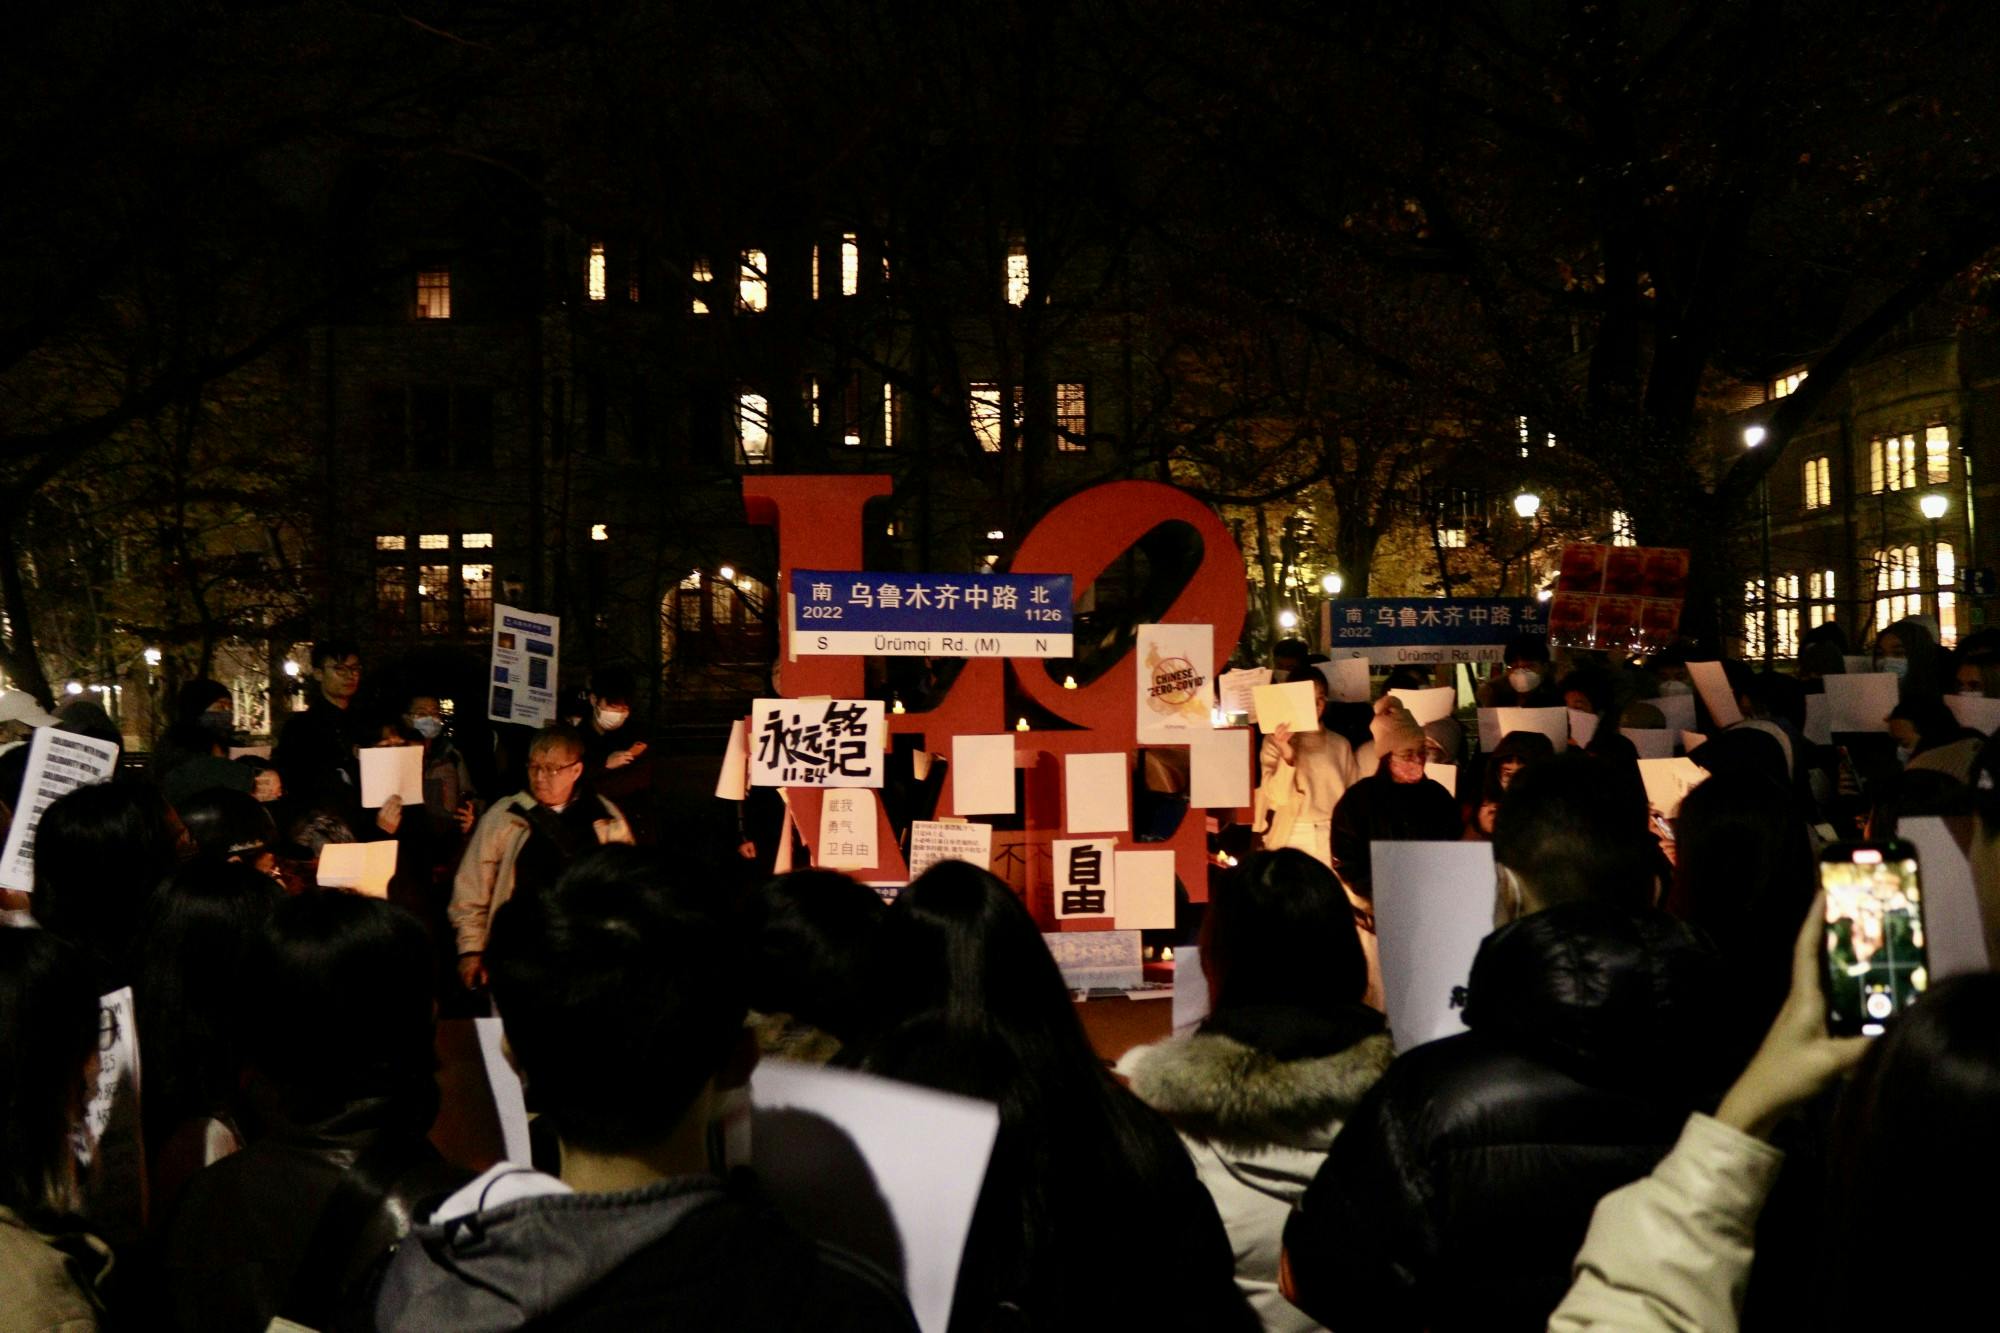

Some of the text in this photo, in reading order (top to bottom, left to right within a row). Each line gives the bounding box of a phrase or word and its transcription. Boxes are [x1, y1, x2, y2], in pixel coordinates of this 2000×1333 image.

[812, 582, 1050, 610] 南 乌鲁木齐中路 北
[803, 606, 1062, 621] 2022 1126
[1345, 606, 1537, 628] 南 乌鲁木齐中路 北
[1339, 623, 1547, 638] 2022 1126
[817, 635, 1048, 654] S Ürümqi Rd. (M) N
[1156, 668, 1193, 685] CHINESE
[782, 768, 827, 783] 11.24
[1062, 844, 1106, 915] 自由
